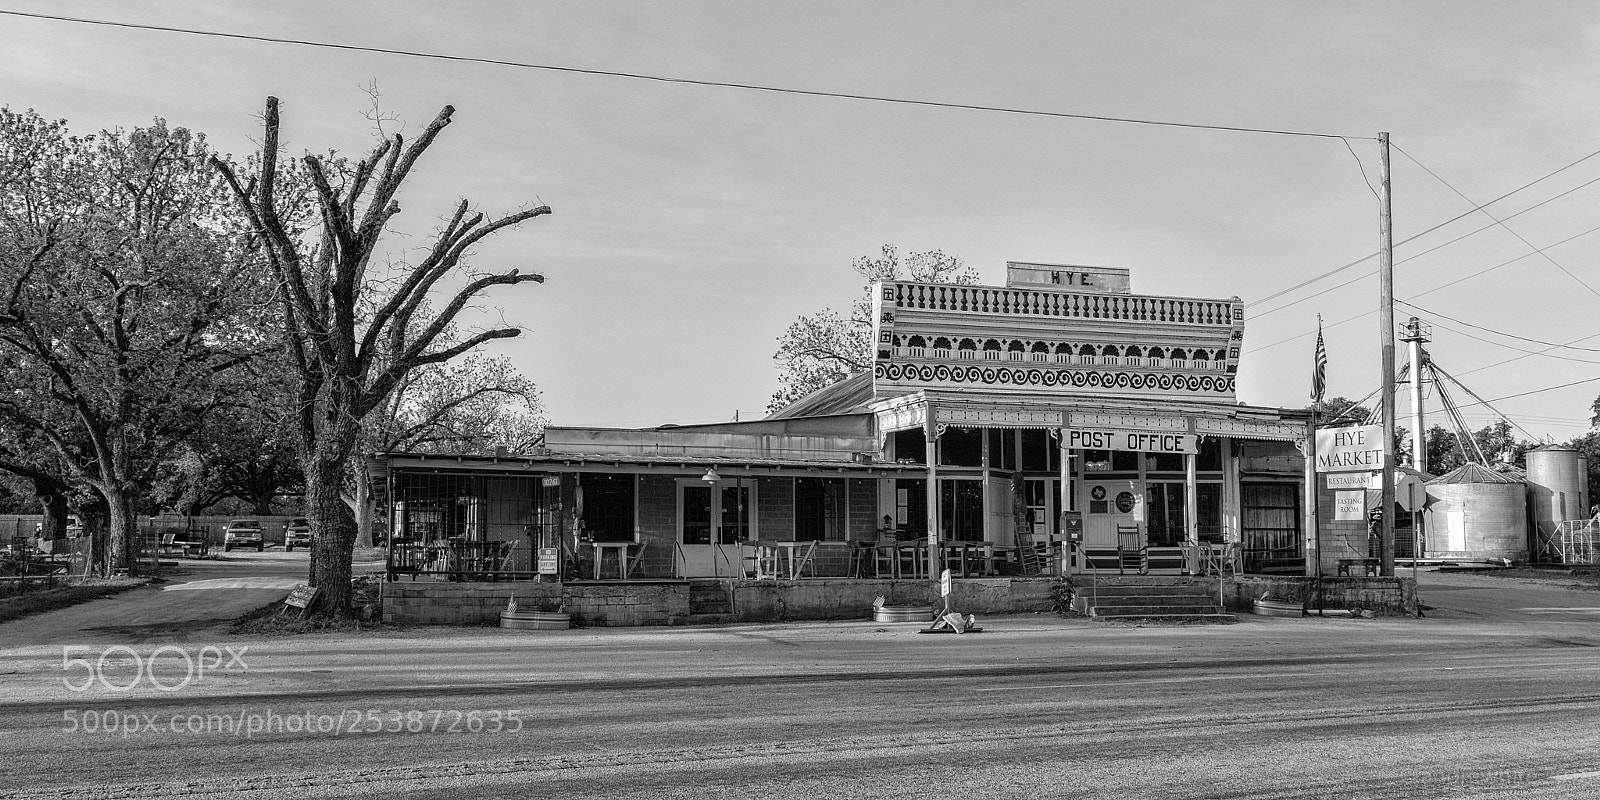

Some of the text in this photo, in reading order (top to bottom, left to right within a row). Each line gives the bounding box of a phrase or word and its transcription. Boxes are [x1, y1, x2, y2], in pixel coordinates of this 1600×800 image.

[1070, 430, 1184, 451] POST OFFICE
[1335, 431, 1364, 446] HYE
[1318, 450, 1382, 467] MARKET
[1328, 476, 1370, 485] RESTAURANT
